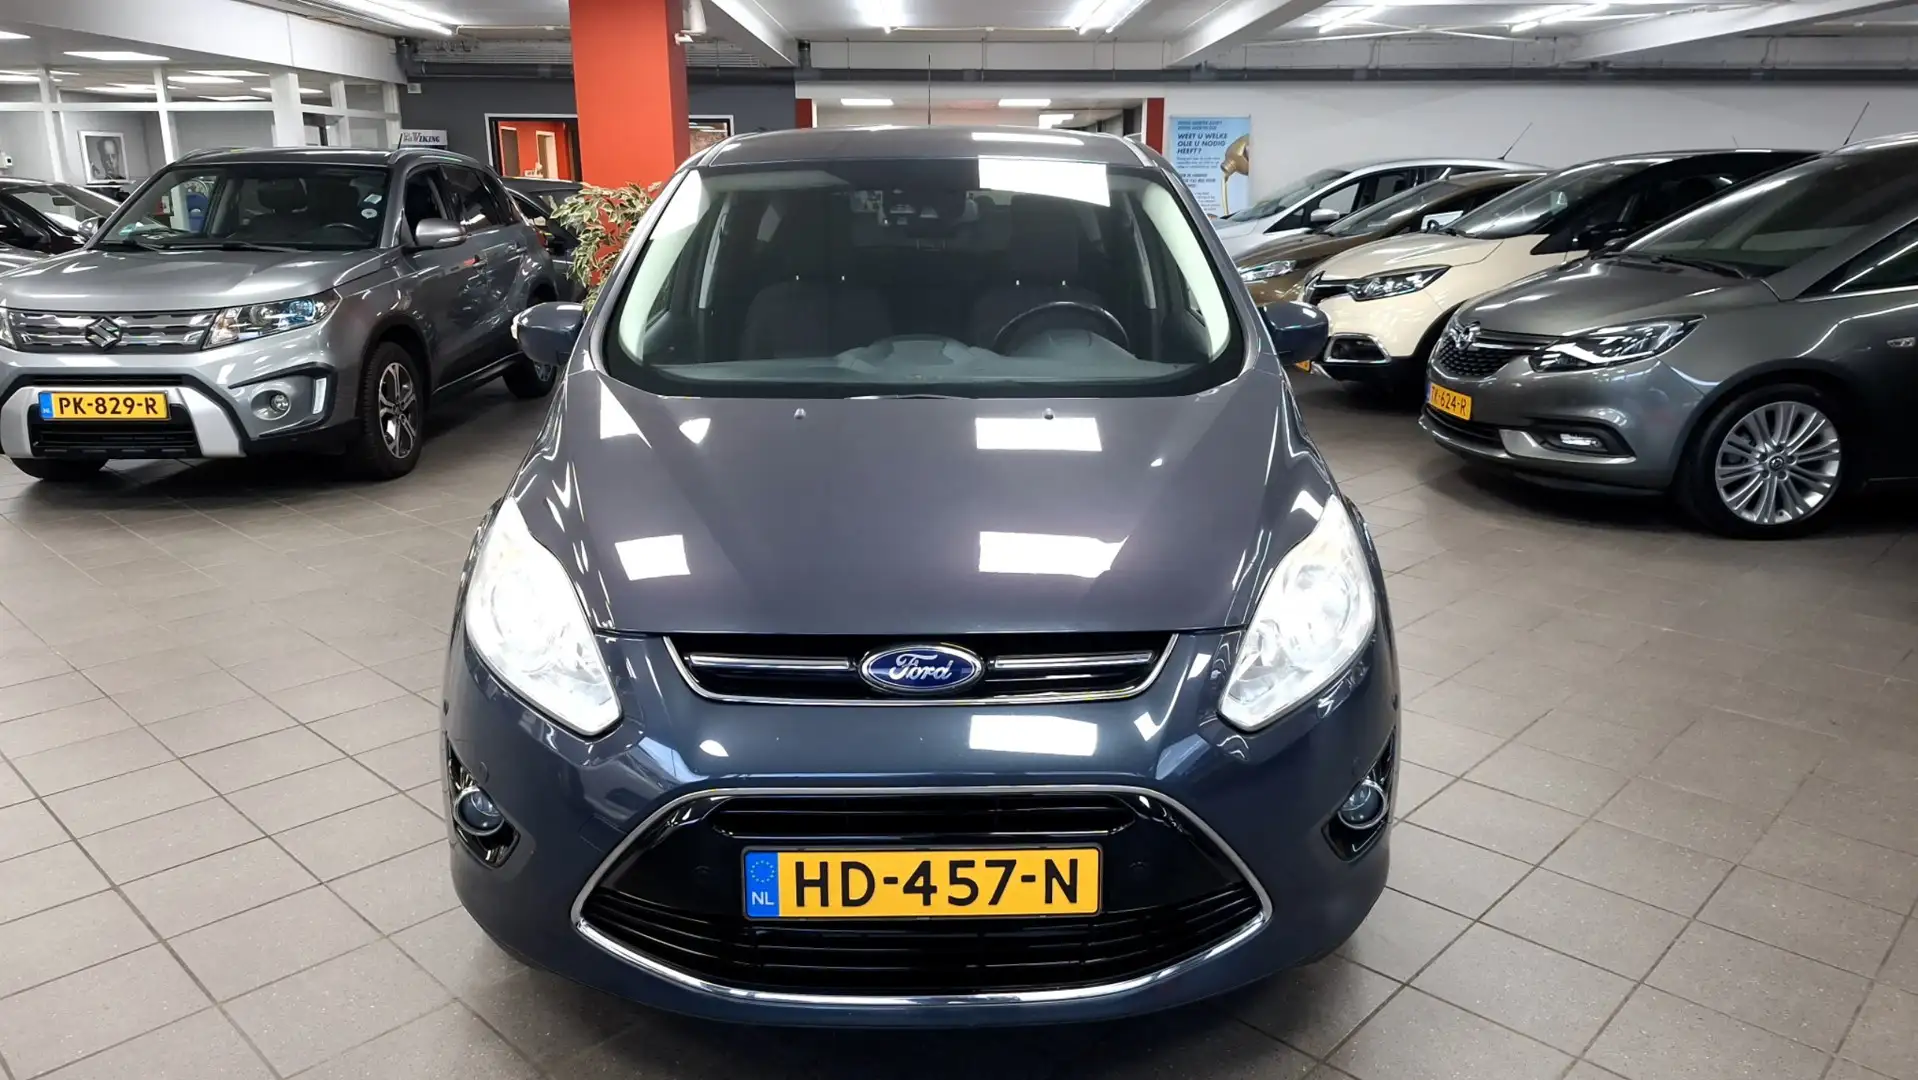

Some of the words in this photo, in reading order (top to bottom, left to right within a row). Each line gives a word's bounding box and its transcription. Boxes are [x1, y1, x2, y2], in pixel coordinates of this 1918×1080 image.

[58, 397, 158, 415] PK-829-R
[1431, 386, 1467, 416] TK-624-R
[888, 653, 954, 680] Ford
[795, 858, 1078, 908] HD-457-N
[751, 891, 775, 906] NL
